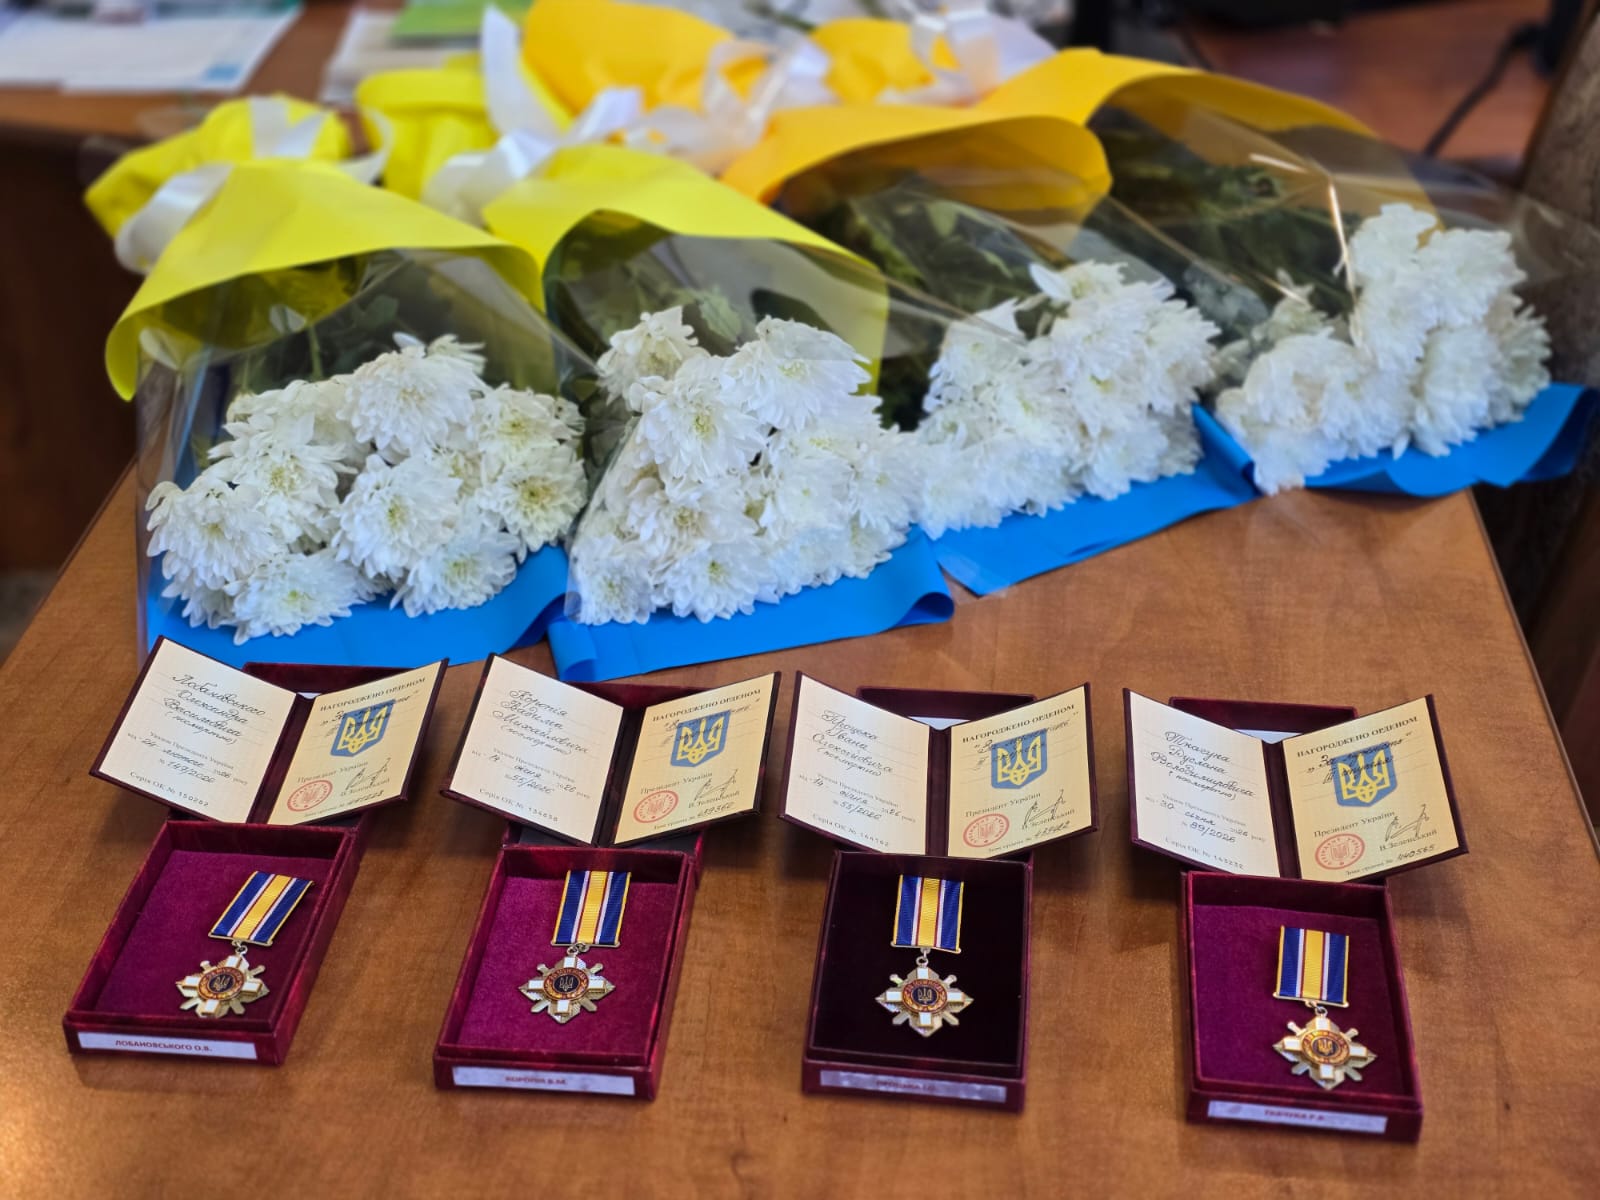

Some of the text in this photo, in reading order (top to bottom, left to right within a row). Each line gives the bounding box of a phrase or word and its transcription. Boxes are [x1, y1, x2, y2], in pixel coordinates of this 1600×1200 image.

[1297, 732, 1370, 757] НАГОРОДЖЕНО
[1371, 716, 1418, 736] ОРДЕНОМ
[1314, 811, 1395, 838] Президент України
[115, 1040, 192, 1050] ЛОБАНОВСЬКОГО
